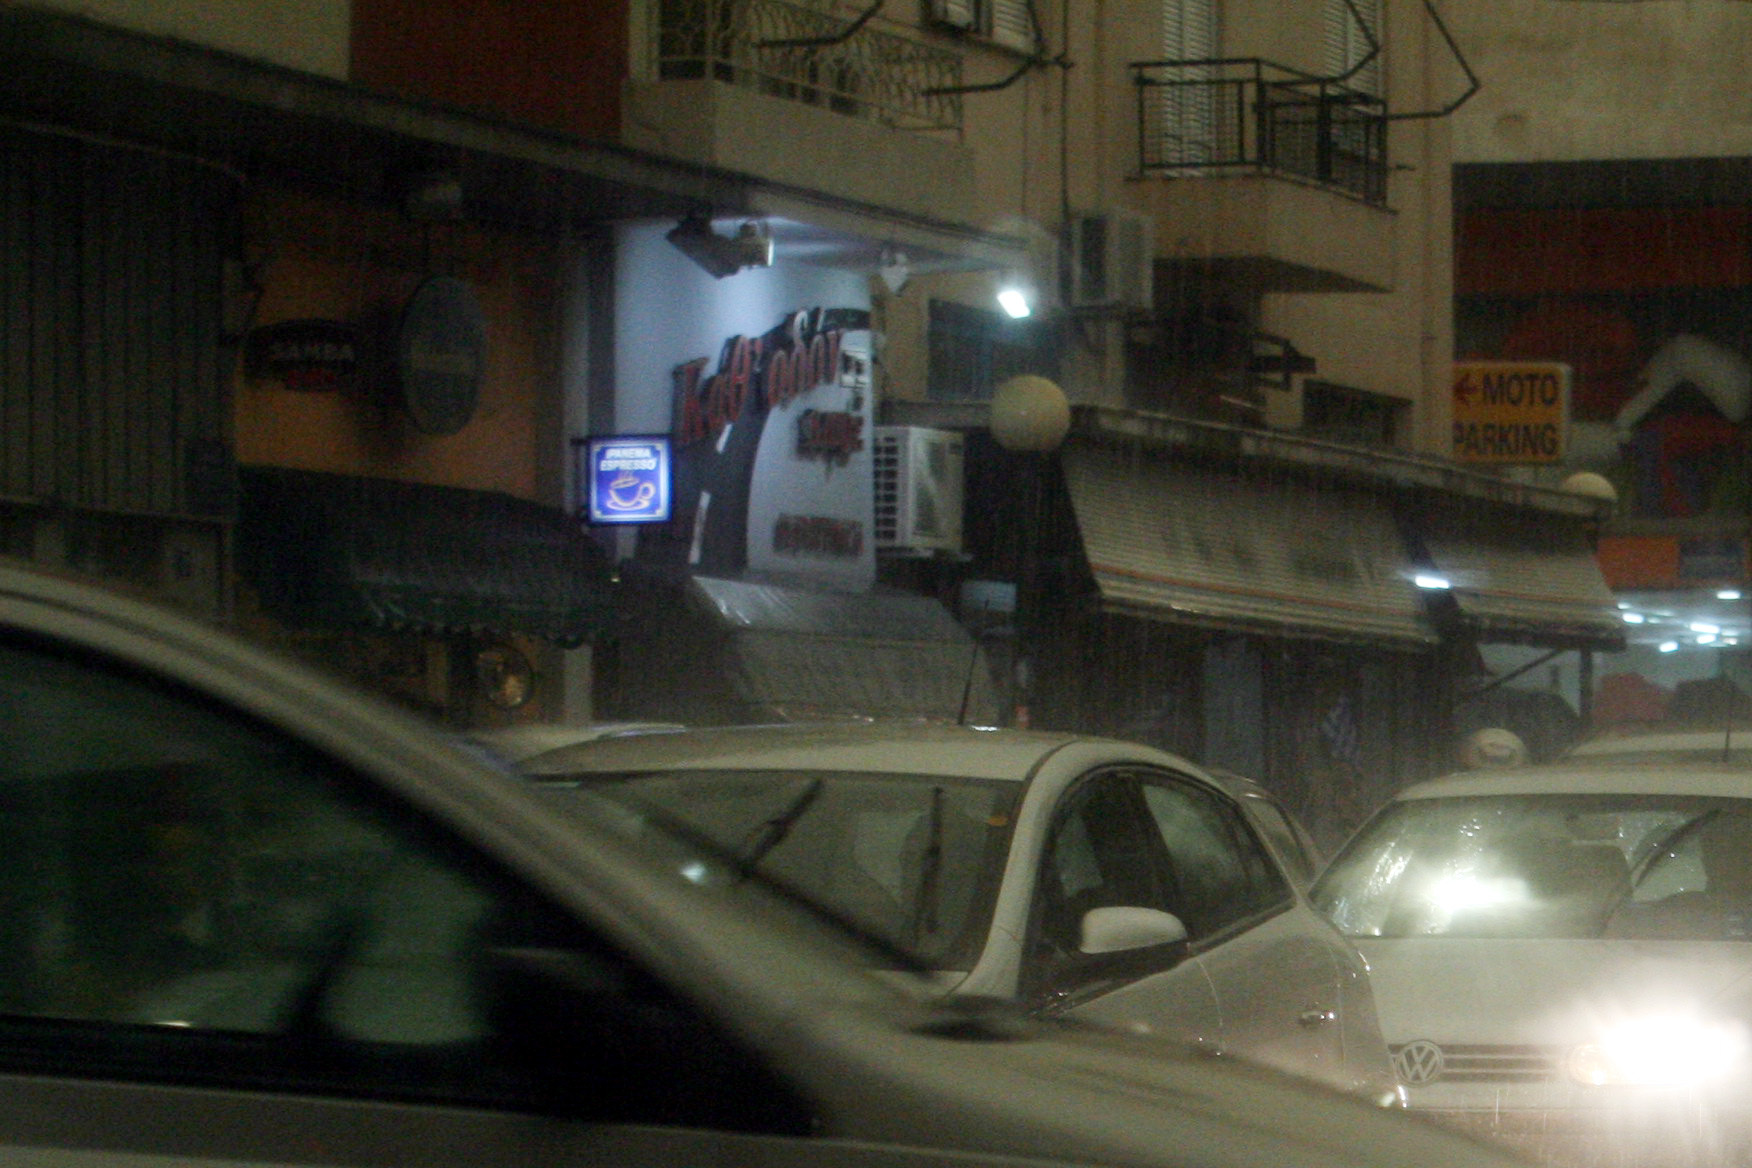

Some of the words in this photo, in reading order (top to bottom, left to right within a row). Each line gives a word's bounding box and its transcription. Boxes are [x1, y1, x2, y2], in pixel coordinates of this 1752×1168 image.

[1483, 373, 1559, 406] MOTO
[1453, 422, 1558, 456] PARKING
[600, 459, 657, 471] ESPRESSO
